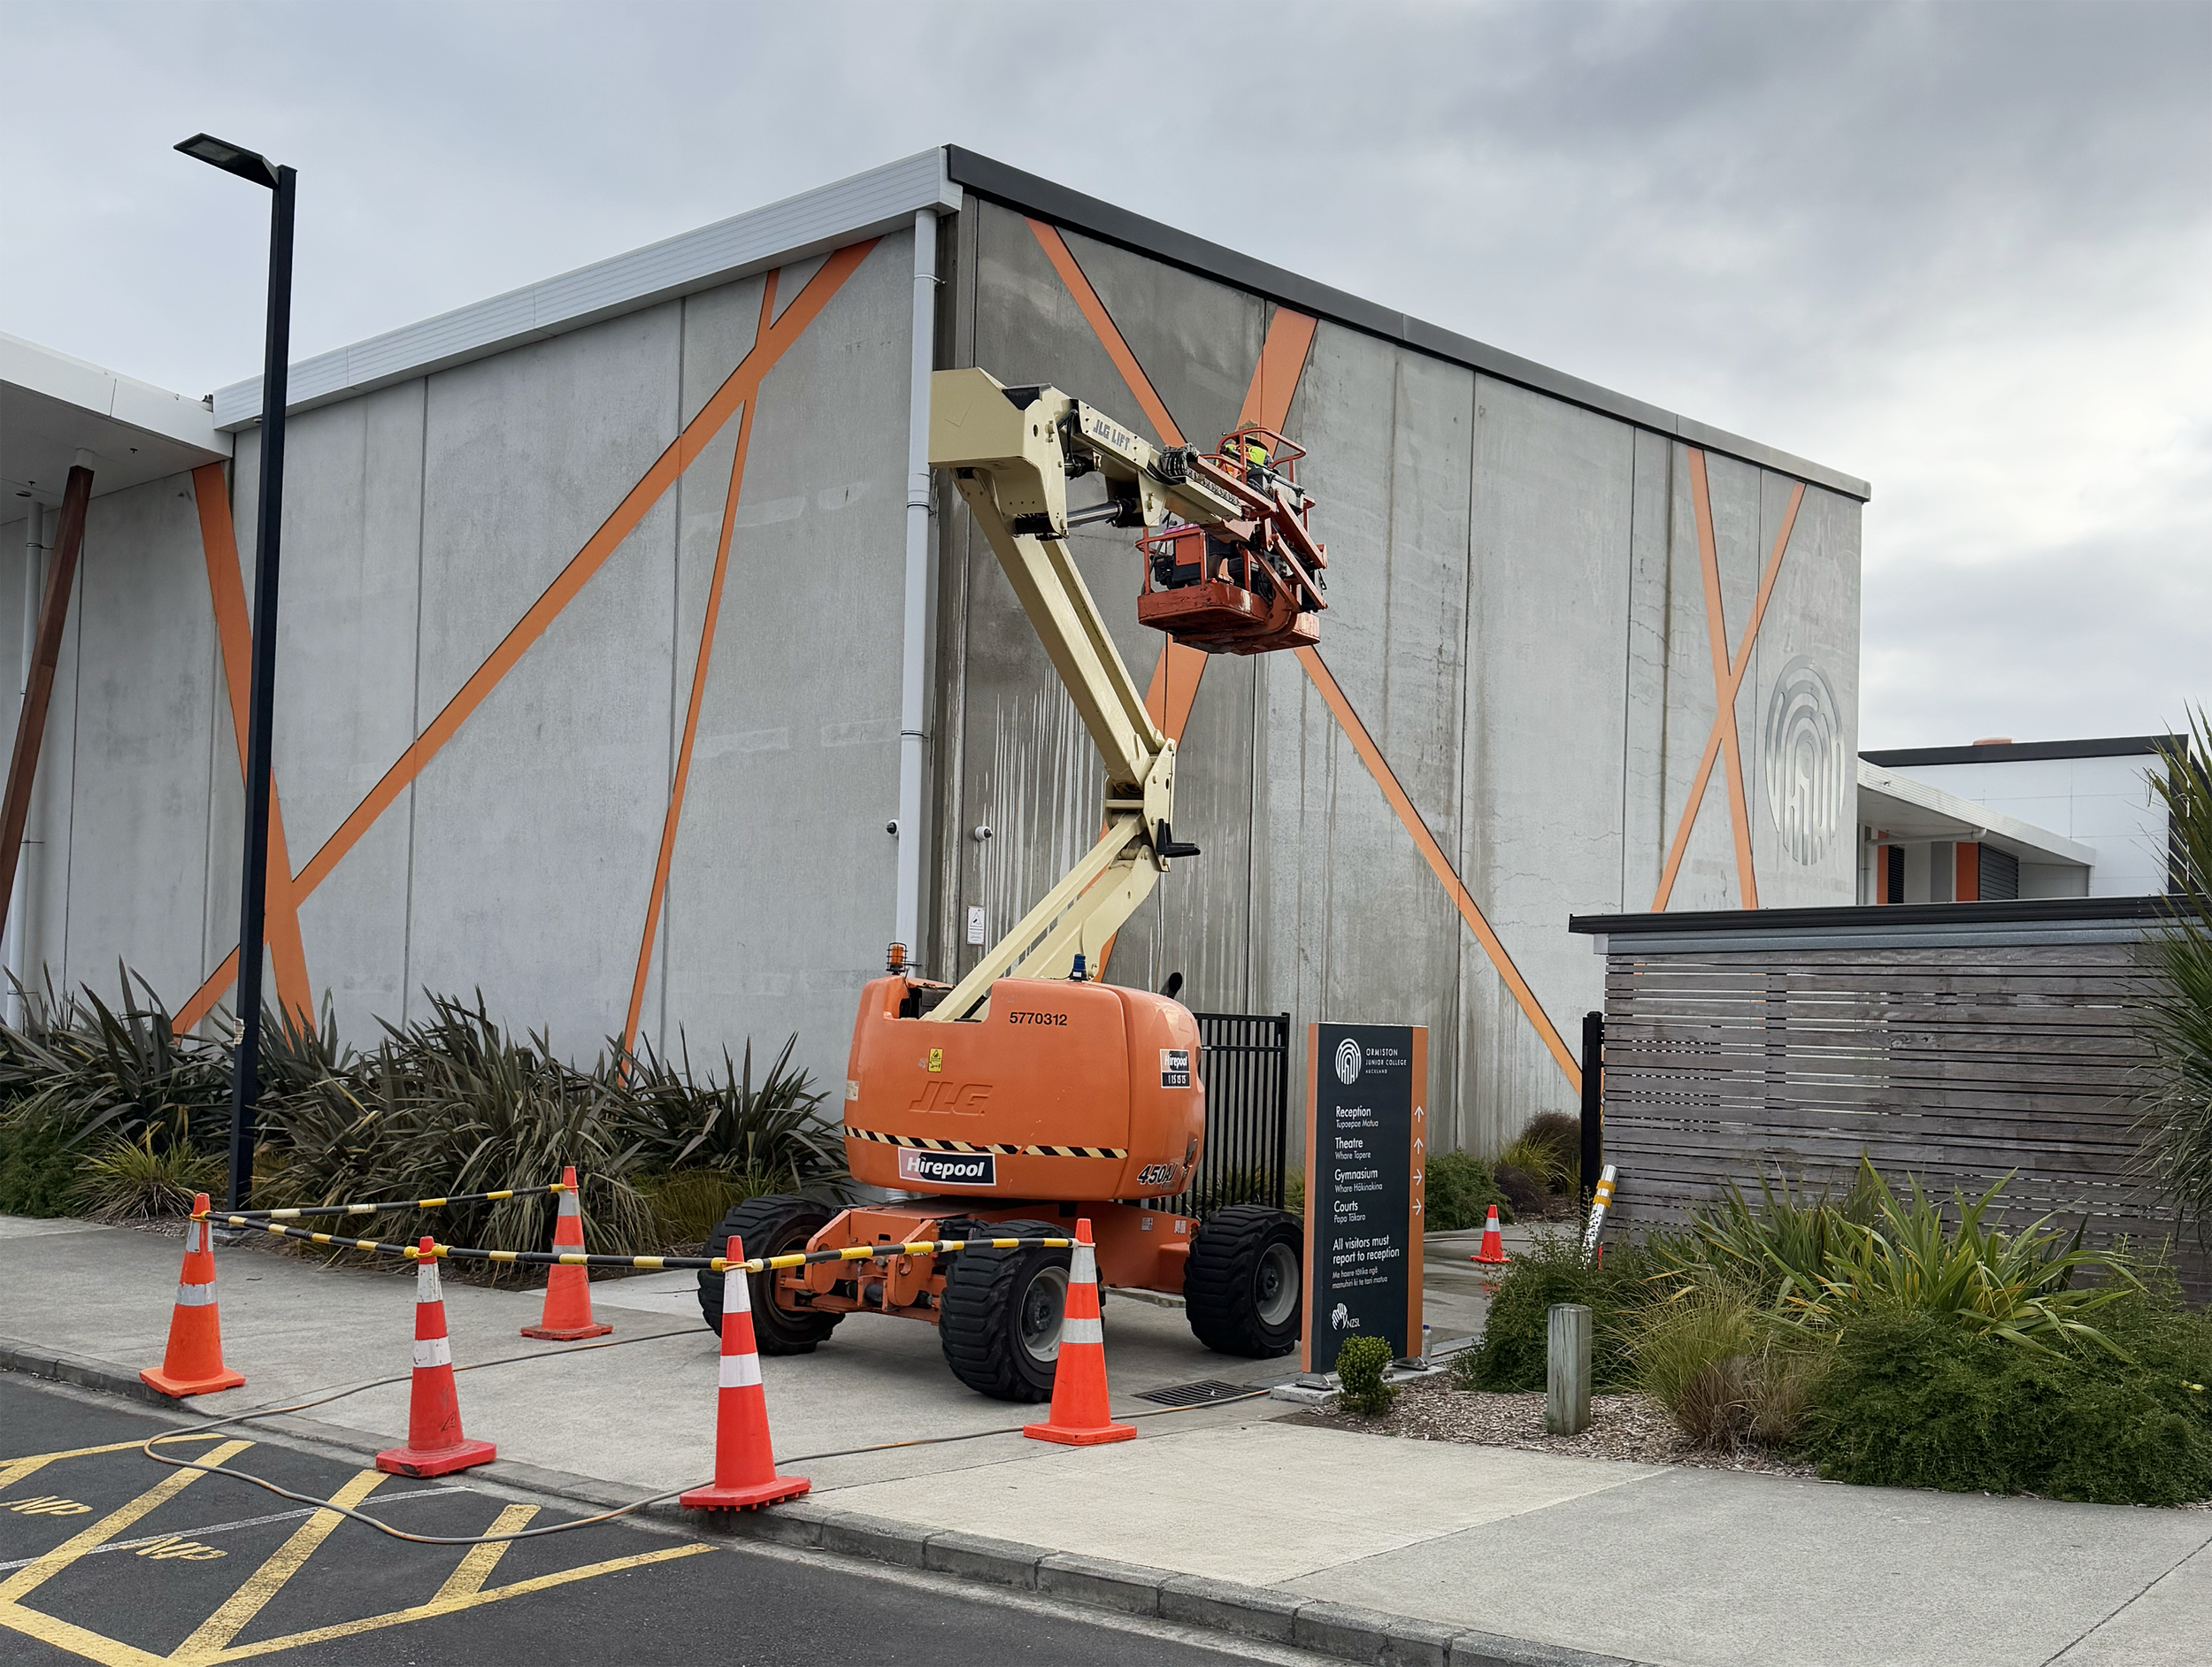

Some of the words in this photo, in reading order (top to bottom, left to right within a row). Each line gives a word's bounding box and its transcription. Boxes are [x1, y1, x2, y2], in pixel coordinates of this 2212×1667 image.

[1093, 419, 1110, 440] JLG
[1111, 429, 1130, 450] LIFT
[1010, 1012, 1067, 1026] 5770312
[1164, 1054, 1187, 1069] Hirepool
[909, 1080, 993, 1117] JLG
[1336, 1105, 1371, 1120] Reception
[1335, 1137, 1363, 1149] Theatre
[1335, 1151, 1353, 1160] Whare
[1354, 1150, 1371, 1161] Tapere
[907, 1156, 985, 1179] Hirepool
[1334, 1167, 1379, 1183] Gymnasium
[1335, 1184, 1353, 1193] Whare
[1333, 1200, 1358, 1212] Courts
[1334, 1215, 1348, 1225] Papa
[1348, 1213, 1366, 1222] Tākaro
[1333, 1238, 1343, 1251] All
[1345, 1237, 1371, 1249] visitors
[1371, 1234, 1389, 1246] must
[1333, 1251, 1356, 1266] report
[1357, 1250, 1365, 1262] to
[1366, 1246, 1400, 1262] reception
[1354, 1278, 1359, 1287] ki
[1364, 1276, 1373, 1285] tari
[1346, 1317, 1361, 1329] NZSL
